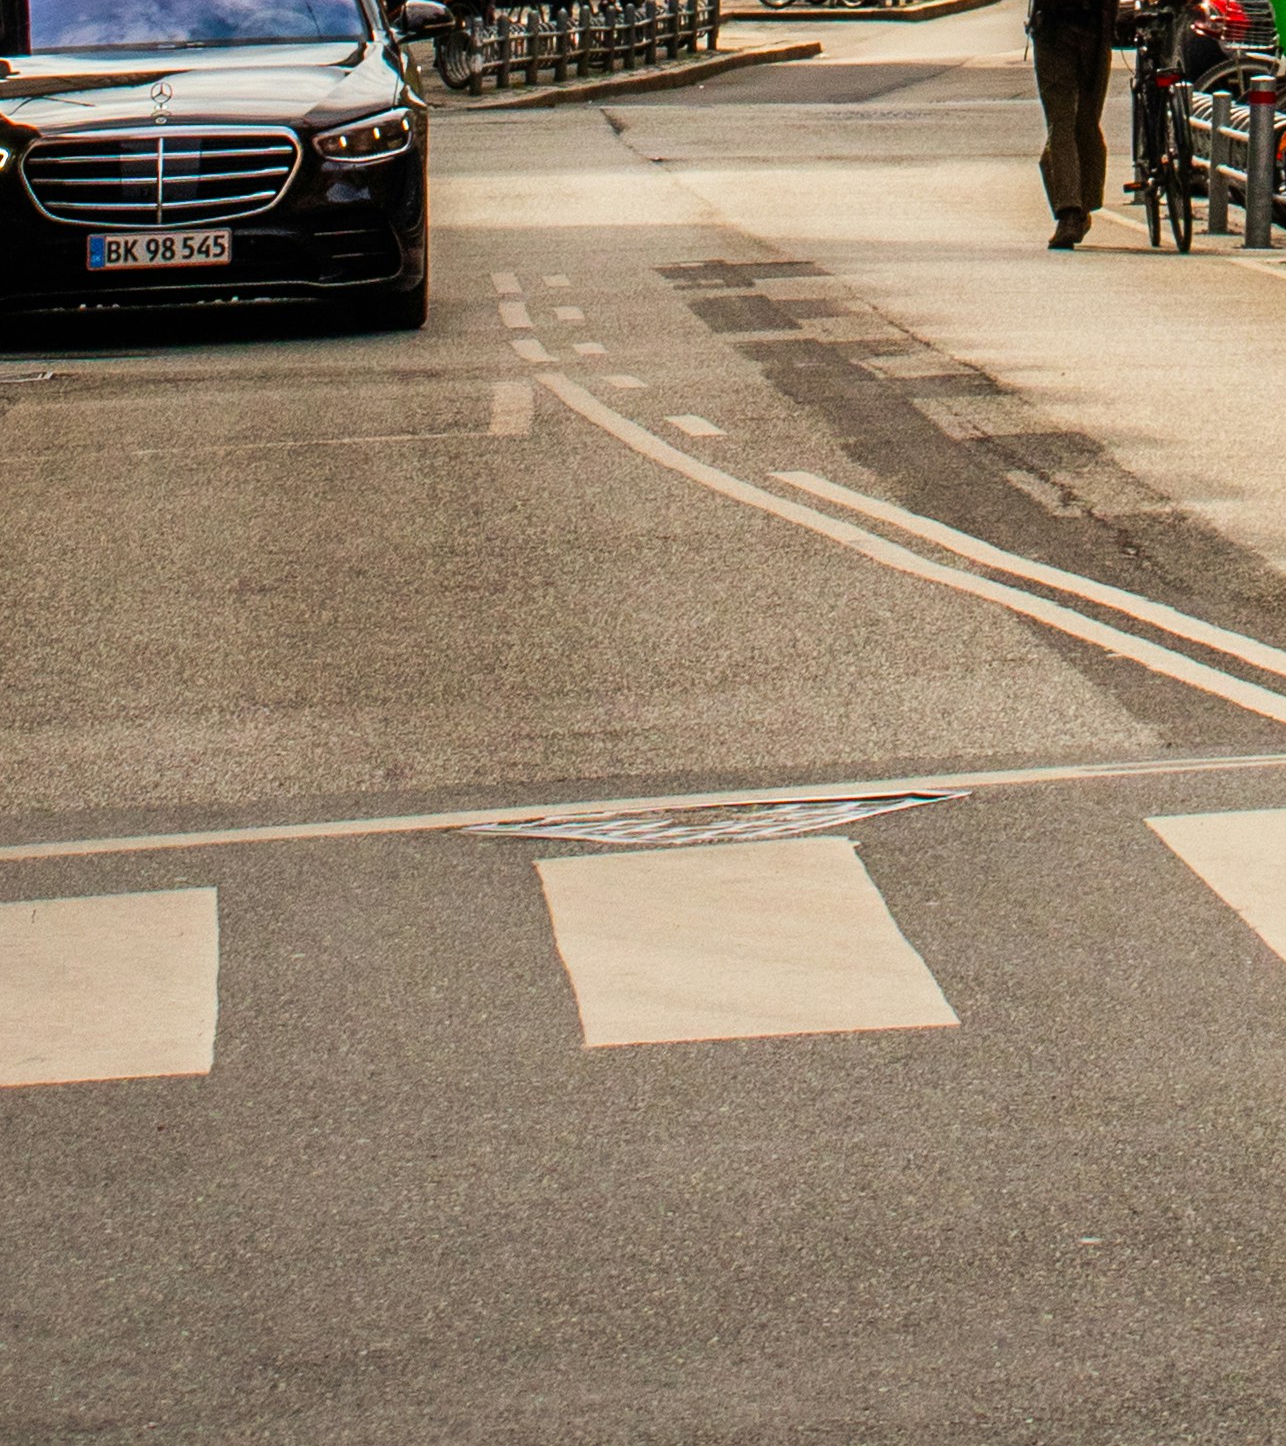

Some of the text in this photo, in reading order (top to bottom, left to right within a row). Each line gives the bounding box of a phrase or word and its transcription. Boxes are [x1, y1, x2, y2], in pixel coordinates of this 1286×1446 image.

[106, 234, 227, 263] BK 98 545
